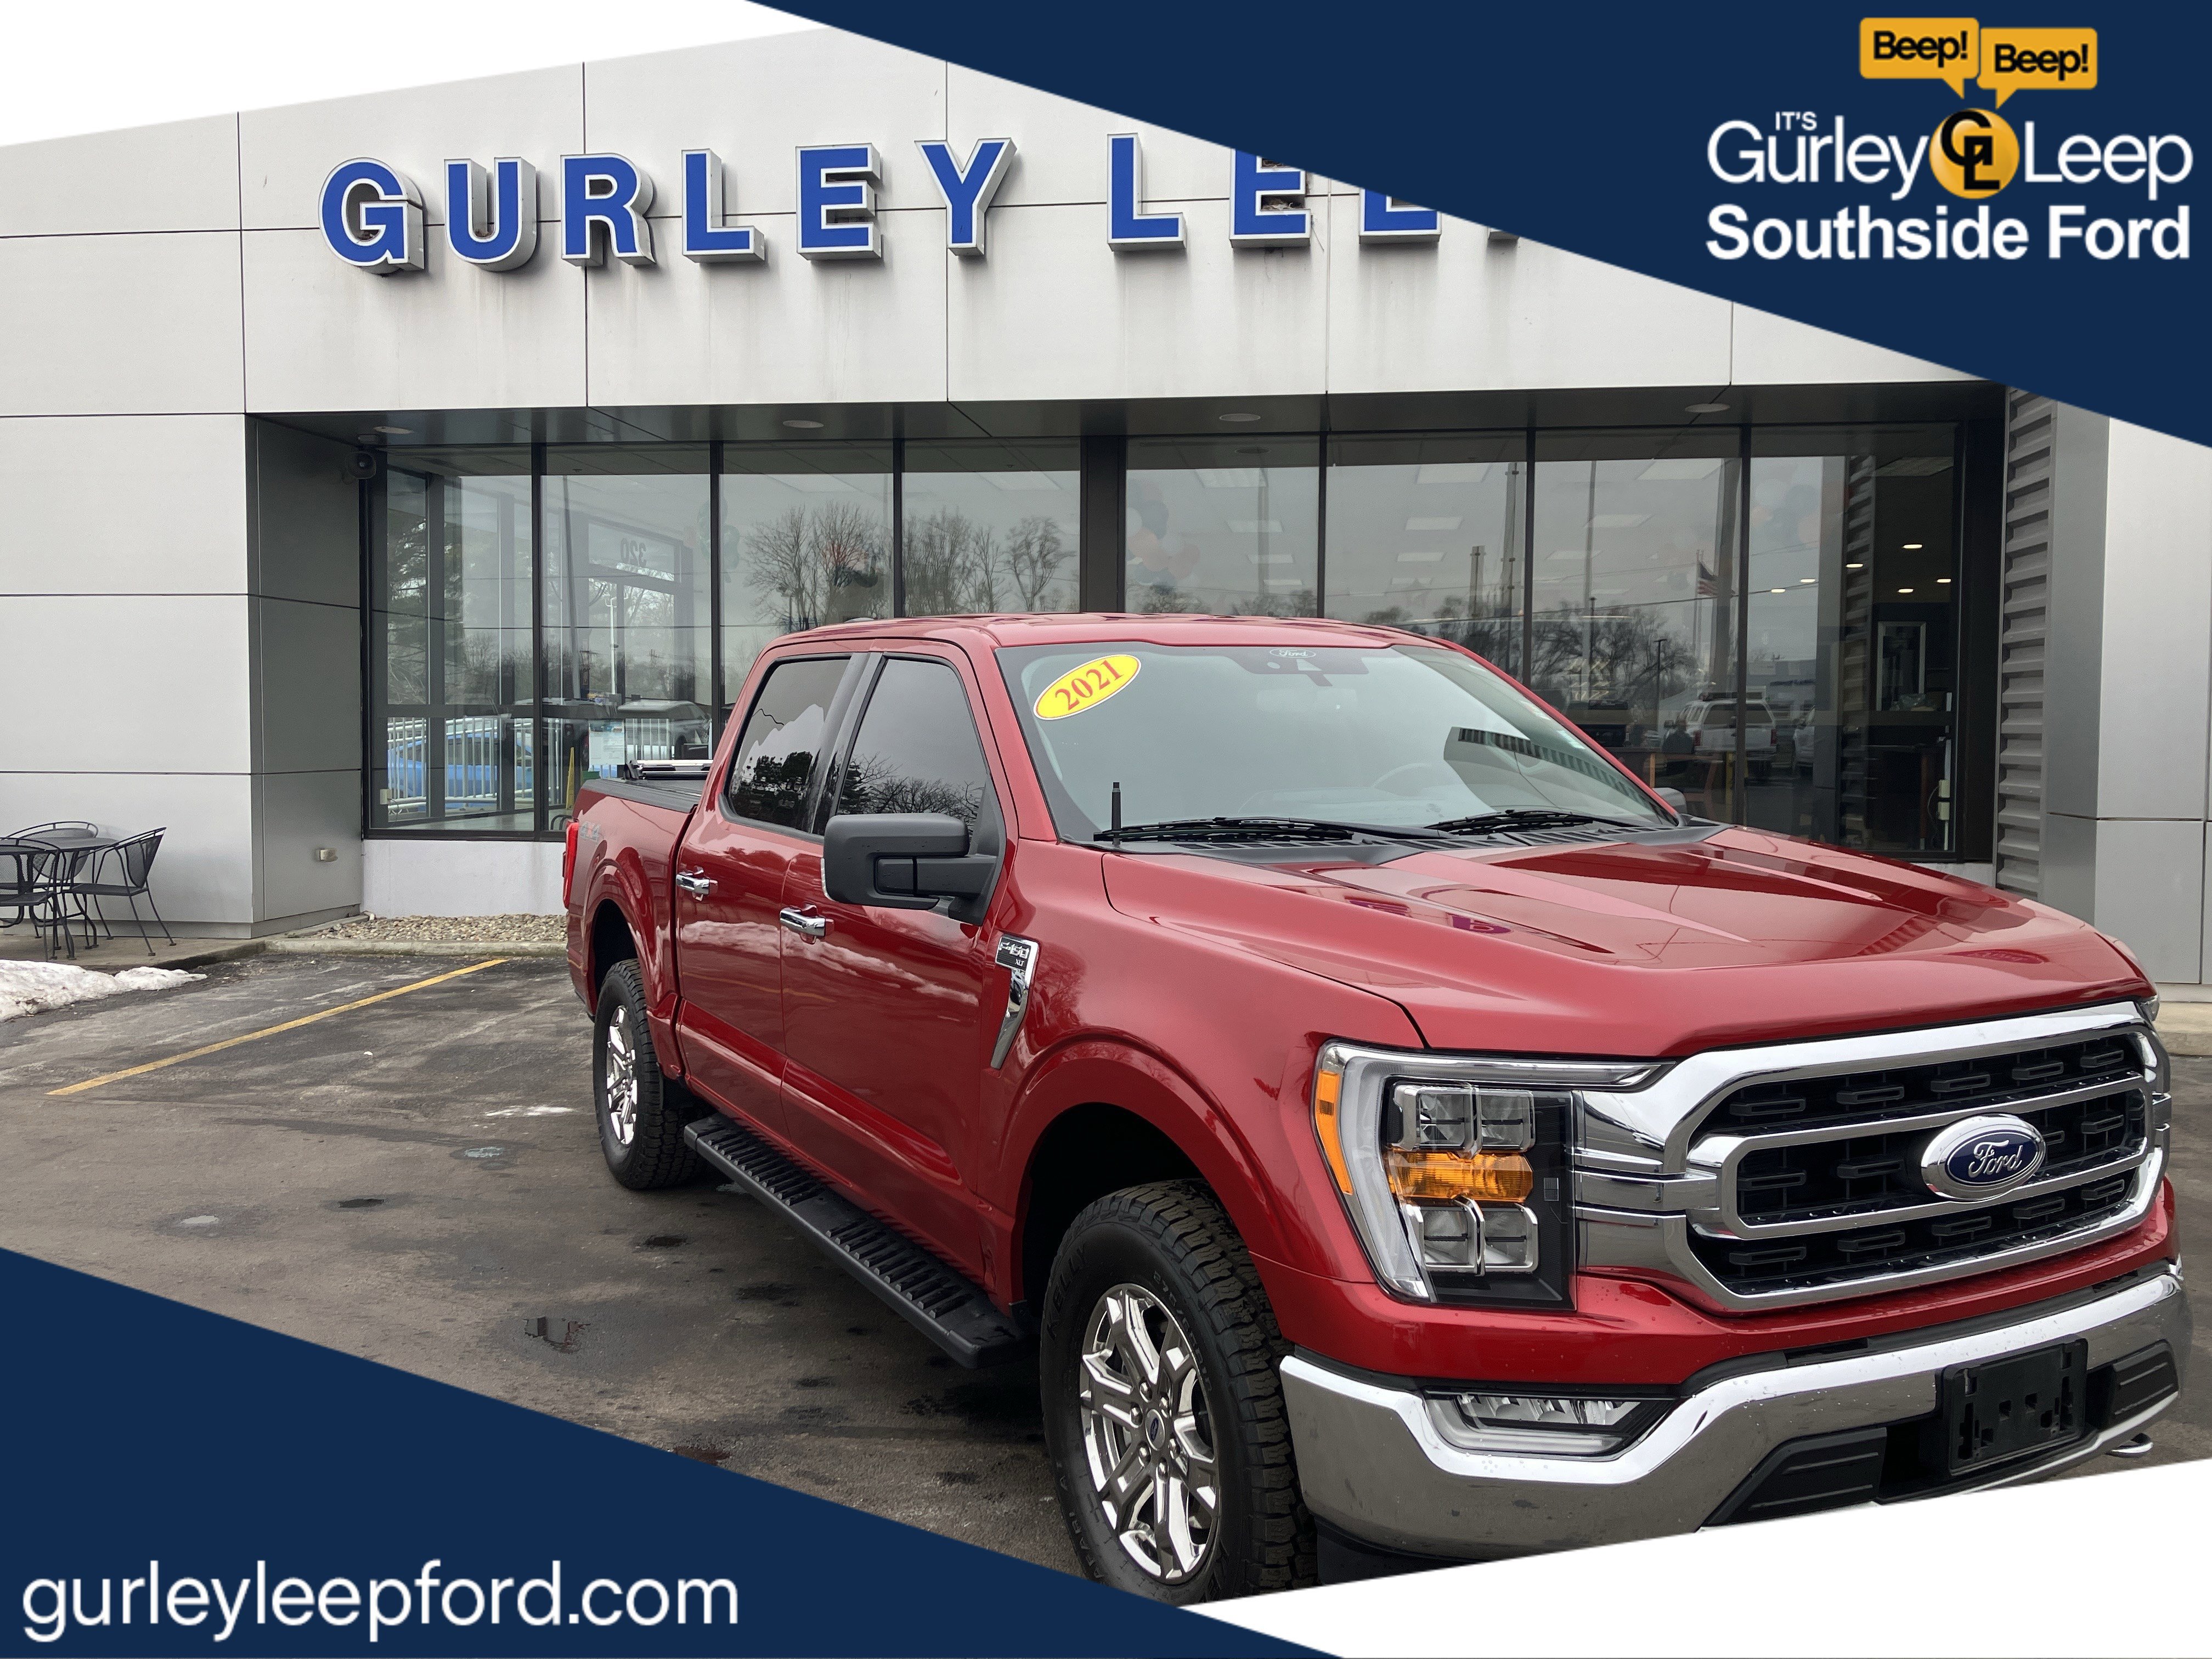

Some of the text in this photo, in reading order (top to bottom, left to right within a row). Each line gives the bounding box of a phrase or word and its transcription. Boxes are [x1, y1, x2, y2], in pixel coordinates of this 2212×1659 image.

[318, 133, 1519, 275] GURLEY LE
[1054, 660, 1124, 711] 2021
[998, 941, 1030, 959] F-150
[1015, 958, 1025, 967] XLT
[1968, 1139, 2023, 1178] Ford
[1046, 1243, 1087, 1342] KELLY
